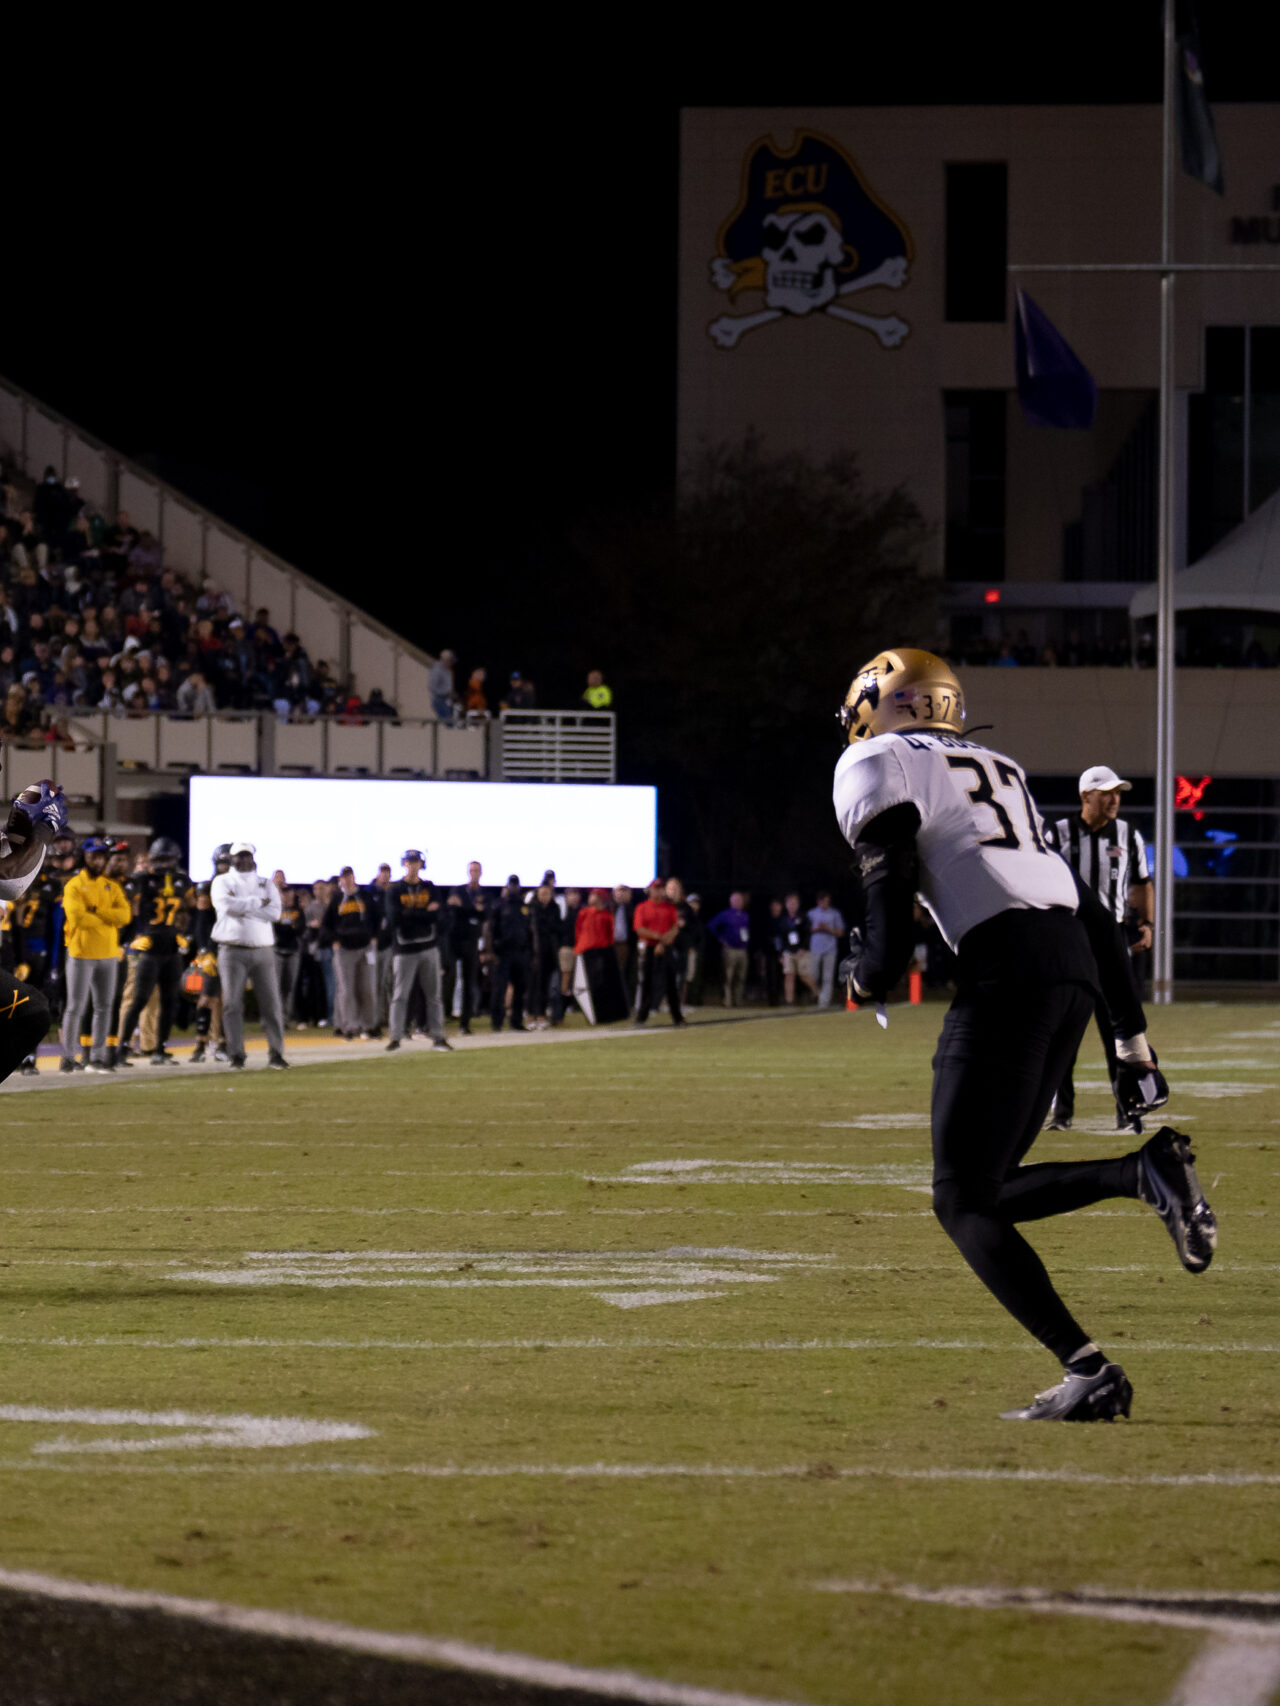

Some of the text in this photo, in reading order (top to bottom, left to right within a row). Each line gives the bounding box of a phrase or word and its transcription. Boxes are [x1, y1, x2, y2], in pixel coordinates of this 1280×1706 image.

[763, 161, 830, 200] ECU
[946, 755, 1048, 854] 37
[149, 896, 181, 926] 37
